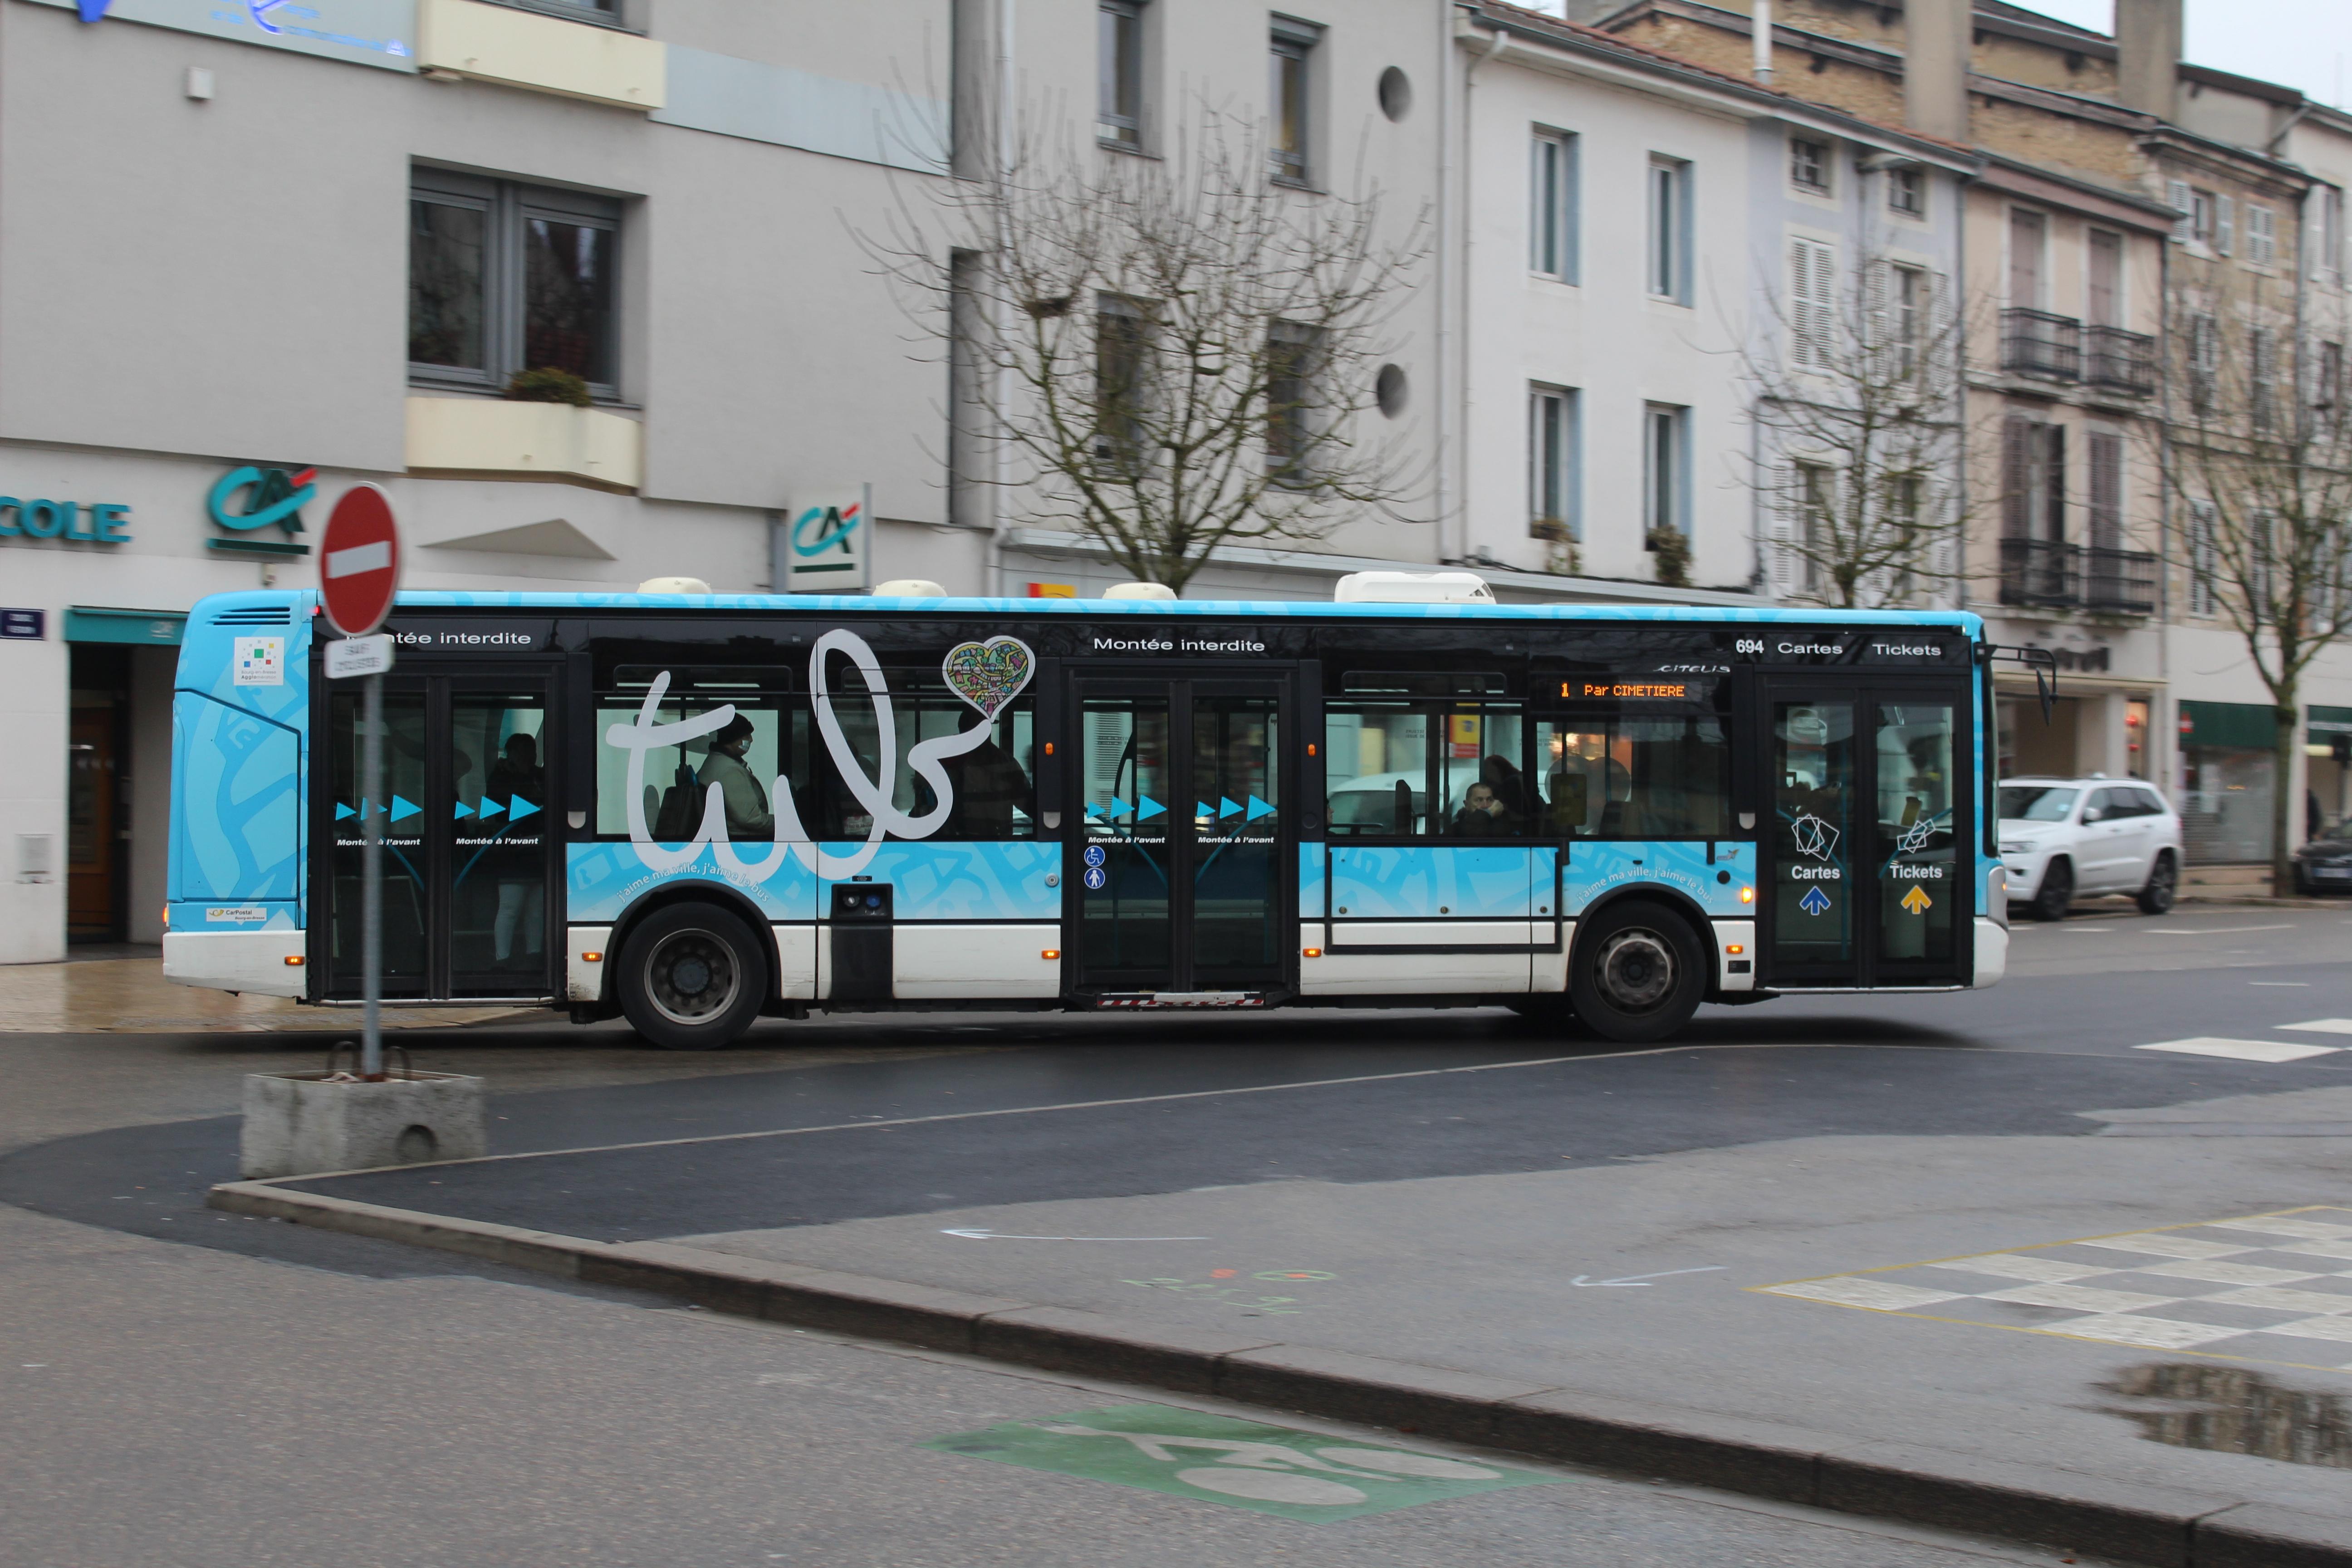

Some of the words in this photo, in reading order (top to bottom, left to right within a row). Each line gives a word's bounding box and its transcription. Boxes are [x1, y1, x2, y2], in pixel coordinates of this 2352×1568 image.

[440, 632, 532, 644] interdite
[1093, 638, 1173, 651] Montée
[1181, 639, 1265, 652] interdite
[1735, 639, 1764, 654] 694
[1777, 642, 1843, 655] Cartes
[1872, 643, 1941, 656] Tickets
[1561, 683, 1569, 698] 1
[1584, 685, 1609, 696] Par
[1613, 685, 1685, 697] CIMETIERE
[1791, 865, 1841, 879] Cartes
[1889, 864, 1943, 879] Tickets
[616, 875, 651, 904] j'aime
[652, 870, 671, 881] ma
[673, 862, 701, 875] ville,
[702, 863, 738, 880] j'aime
[739, 873, 751, 887] le
[750, 881, 770, 903] bus
[1577, 877, 1607, 904] j'aime
[1608, 872, 1625, 883] ma
[1627, 867, 1652, 877] ville,
[1654, 867, 1686, 884] j'aime
[1687, 878, 1698, 890] le
[1697, 885, 1714, 905] bus
